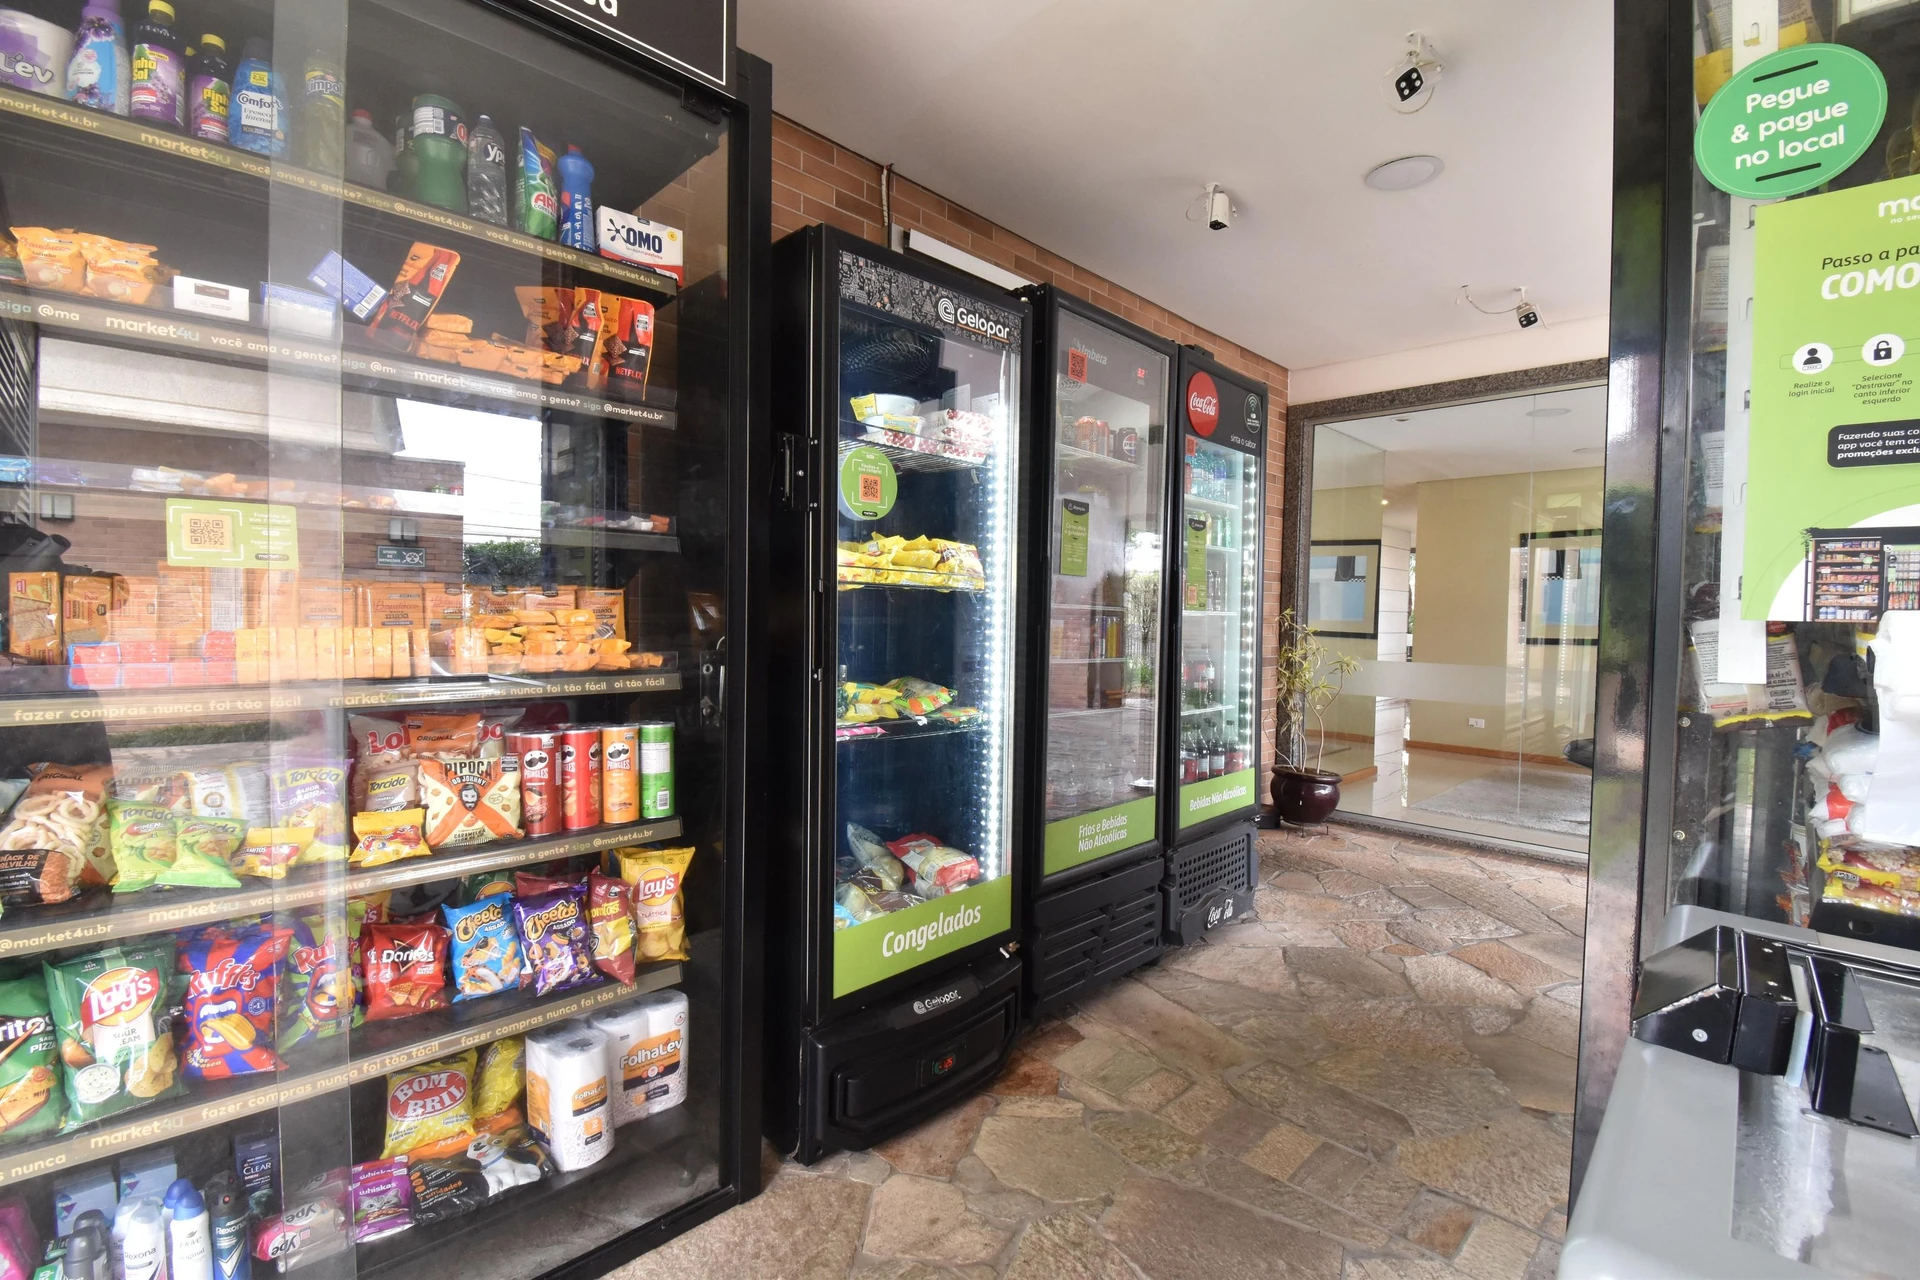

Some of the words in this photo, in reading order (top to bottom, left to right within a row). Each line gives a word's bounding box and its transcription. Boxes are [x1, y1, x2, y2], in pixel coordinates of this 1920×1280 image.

[237, 92, 283, 109] Comfort
[1746, 79, 1830, 114] Pegue
[1730, 124, 1750, 144] &
[1758, 101, 1849, 142] pague
[1735, 150, 1770, 170] no
[1778, 124, 1845, 159] local
[141, 132, 230, 166] market4u
[241, 161, 270, 175] você
[277, 170, 305, 184] ama
[309, 179, 318, 187] a
[321, 182, 362, 200] gente?
[394, 201, 474, 232] @market4u.br
[486, 229, 510, 243] você
[512, 237, 535, 250] ama
[546, 247, 577, 263] gente?
[1890, 216, 1903, 225] no
[625, 226, 663, 254] OMO
[1821, 252, 1873, 271] Passo
[1879, 249, 1890, 261] a
[1821, 261, 1920, 300] COMO
[389, 309, 421, 331] NETFLIX
[957, 307, 1010, 339] Gelopar
[38, 303, 80, 322] @ma
[105, 315, 200, 342] market4u
[211, 334, 243, 348] você
[247, 340, 278, 354] ama
[281, 347, 290, 356] a
[294, 350, 338, 366] gente?
[516, 390, 538, 400] ama
[549, 395, 580, 410] gente?
[583, 399, 602, 412] siga
[604, 403, 663, 422] @market4u.br
[615, 366, 643, 379] NETFLIX
[1862, 372, 1903, 382] Selecione
[1788, 389, 1810, 398] login
[1810, 386, 1835, 395] inicial
[1793, 381, 1823, 389] Realize
[1853, 389, 1877, 398] canto
[1879, 387, 1911, 396] inferior
[1862, 395, 1902, 405] esquerdo
[1837, 441, 1858, 451] app
[1860, 438, 1883, 448] você
[1885, 438, 1906, 446] tem
[1838, 431, 1881, 441] Fazendo
[1882, 430, 1905, 438] suas
[1836, 448, 1894, 461] promoções
[13, 708, 63, 722] fazer
[70, 705, 147, 721] compras
[153, 703, 203, 715] nunca
[209, 699, 231, 712] foi
[236, 699, 263, 710] tão
[269, 696, 302, 709] fácil
[510, 684, 544, 695] nunca
[547, 682, 561, 693] foi
[564, 682, 582, 692] tão
[585, 680, 607, 692] fácil
[614, 680, 624, 689] oi
[626, 679, 643, 688] tão
[645, 677, 666, 687] fácil
[416, 734, 455, 743] ORIGINAL
[444, 759, 494, 781] PIPOCA
[523, 767, 549, 780] PRINGLES
[606, 760, 631, 771] PRINGLES
[289, 768, 341, 784] Torcida
[369, 775, 408, 793] Torcida
[1189, 796, 1211, 811] Bebidas
[1211, 791, 1222, 806] Não
[1222, 785, 1247, 802] Alcoólicas
[121, 806, 175, 821] Torcida
[1078, 822, 1095, 838] Frios
[1096, 823, 1101, 833] e
[1101, 813, 1128, 832] Bebidas
[1078, 837, 1094, 853] Não
[1094, 829, 1128, 848] Alcoólicas
[0, 854, 25, 864] NACK
[27, 853, 40, 862] DE
[0, 923, 114, 949] @market4u.br
[148, 899, 240, 923] market4u
[249, 896, 282, 908] você
[285, 889, 314, 902] ama
[318, 887, 326, 897] a
[330, 878, 372, 896] gente?
[503, 853, 527, 864] ama
[528, 851, 536, 860] a
[537, 845, 570, 860] gente?
[572, 842, 591, 852] siga
[593, 829, 654, 848] @market4u.br
[639, 875, 675, 901] Lay's
[525, 900, 579, 942] Cheetos
[552, 918, 577, 931] ASSADO
[882, 904, 982, 958] Congelados
[381, 947, 435, 963] Doritos
[187, 957, 261, 1000] Ruffles
[89, 973, 152, 1022] Lay's
[924, 989, 961, 1011] Gelopar
[29, 1041, 57, 1055] PIZZA
[619, 1037, 684, 1069] FolhaLev
[11, 1152, 67, 1178] nunca
[90, 1117, 184, 1149] market4u
[201, 1102, 244, 1121] fazer
[248, 1083, 313, 1108] compras
[317, 1069, 359, 1090] nunca
[362, 1060, 382, 1077] foi
[385, 1052, 409, 1069] tão
[411, 1042, 440, 1061] fácil
[460, 1030, 492, 1047] fazer
[495, 1014, 544, 1036] compras
[546, 1003, 578, 1020] nunca
[579, 994, 595, 1010] foi
[597, 989, 614, 1004] tão
[616, 982, 639, 999] fácil
[394, 1072, 450, 1104] BOM
[406, 1084, 465, 1117] BRIL
[574, 1083, 606, 1101] FolhaLev
[591, 1120, 599, 1130] 2
[243, 1162, 272, 1175] CLEAR
[359, 1182, 398, 1196] whiskas
[425, 1180, 463, 1199] unidades
[215, 1221, 247, 1236] Rexona
